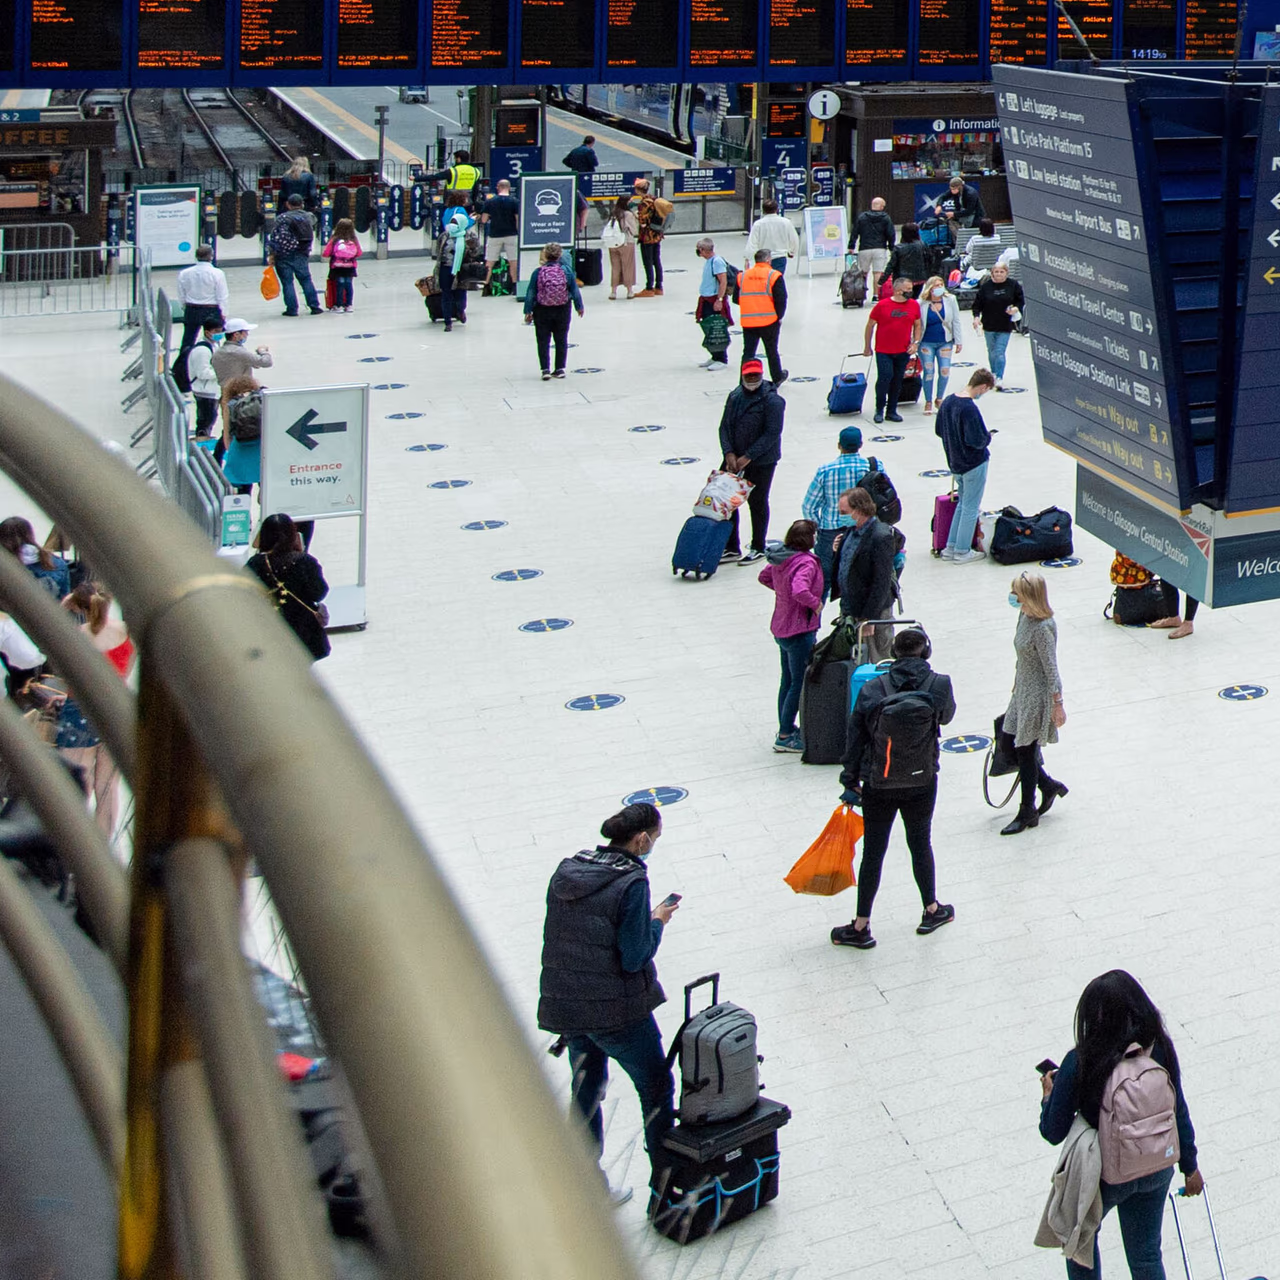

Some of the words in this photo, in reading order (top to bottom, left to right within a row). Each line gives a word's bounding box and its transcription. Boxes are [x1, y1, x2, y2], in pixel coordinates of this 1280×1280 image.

[1020, 96, 1033, 112] Left
[1035, 99, 1057, 120] luggage
[1020, 129, 1038, 148] Cycle
[1039, 133, 1053, 150] Park
[1054, 137, 1083, 156] Platform
[1083, 142, 1092, 158] 15
[509, 160, 522, 178] 3
[1029, 164, 1043, 181] Low
[1044, 169, 1058, 186] level
[1059, 174, 1082, 191] station
[1044, 249, 1076, 273] Accessible
[1077, 261, 1095, 280] toilet
[1044, 281, 1067, 305] Tickets
[1068, 290, 1080, 309] and
[1080, 294, 1101, 315] Travel
[1101, 301, 1125, 325] Centre
[1104, 336, 1130, 362] Tickets
[1033, 339, 1049, 360] Taxis
[1050, 348, 1062, 366] and
[1063, 352, 1090, 379] Glasgow
[1090, 364, 1115, 388] Station
[1115, 376, 1132, 397] Link
[289, 462, 342, 474] Entrance
[290, 477, 312, 486] this
[316, 475, 341, 484] way.
[1082, 491, 1107, 519] Welcome
[1107, 507, 1113, 522] to
[1114, 511, 1140, 538] Glasgow
[1140, 526, 1164, 553] Central
[1164, 540, 1188, 568] Station
